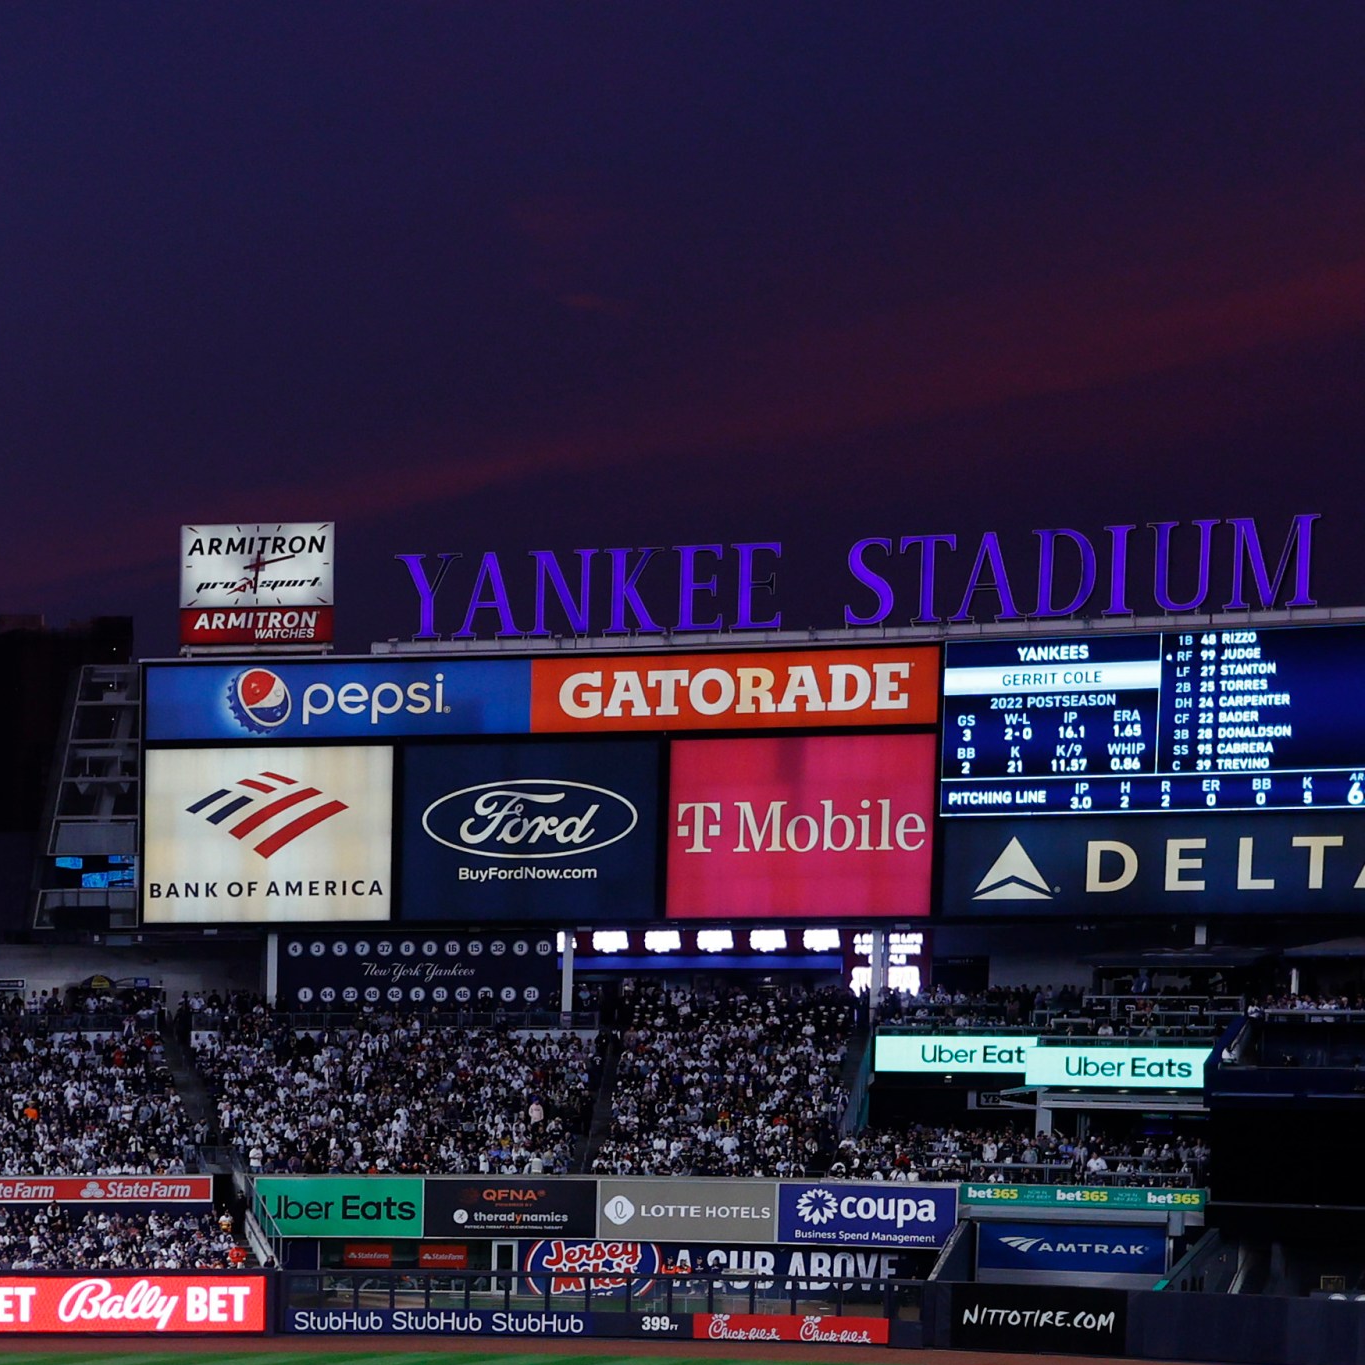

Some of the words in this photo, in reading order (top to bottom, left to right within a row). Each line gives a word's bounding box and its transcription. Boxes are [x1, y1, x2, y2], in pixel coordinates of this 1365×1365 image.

[188, 535, 326, 556] ARMITRON
[259, 577, 320, 591] sport
[394, 541, 782, 640] YANKEE
[844, 512, 1322, 626] STADIUM
[194, 611, 317, 630] ARMITRON
[255, 628, 315, 639] WATCHES
[1178, 635, 1193, 646] 1B
[1200, 634, 1216, 645] 48
[1221, 632, 1257, 645] RIZZO
[1017, 645, 1089, 662] YANKEES
[1176, 650, 1192, 662] RF
[1200, 649, 1216, 661] 99
[1220, 647, 1261, 660] JUDGE
[1176, 666, 1191, 677] LF
[1200, 665, 1216, 676] 27
[1220, 662, 1277, 675] STANTON
[1002, 672, 1058, 687] GERRIT
[1063, 670, 1102, 684] COLE
[1175, 682, 1191, 693] 2B
[1199, 681, 1215, 692] 25
[1219, 679, 1268, 692] TORRES
[301, 672, 444, 724] pepsi
[558, 662, 910, 718] GATORADE
[990, 697, 1023, 709] 2022
[1027, 694, 1116, 708] POSTSEASON
[1174, 697, 1192, 708] DH
[1198, 697, 1214, 708] 24
[1218, 694, 1290, 707] CARPENTER
[957, 715, 976, 727] GS
[1005, 713, 1030, 725] W-L
[1064, 711, 1078, 723] IP
[1114, 710, 1141, 722] ERA
[1174, 713, 1190, 724] CF
[1198, 712, 1213, 724] 22
[1218, 711, 1259, 722] BADER
[1058, 725, 1085, 738] 16.1
[1113, 723, 1142, 737] 1.65
[1173, 729, 1189, 740] 3B
[1197, 728, 1212, 739] 28
[1217, 725, 1291, 738] DONALDSON
[957, 747, 976, 759] BB
[1056, 744, 1082, 757] K/9
[1108, 743, 1145, 755] WHIP
[1173, 745, 1189, 755] SS
[1197, 743, 1212, 755] 95
[1216, 742, 1274, 754] CABRERA
[1007, 760, 1022, 773] 21
[1051, 758, 1087, 772] 11.57
[1110, 757, 1141, 770] 0.86
[1196, 759, 1211, 771] 39
[1216, 757, 1269, 770] TREVINO
[1075, 782, 1089, 794] IP
[1202, 779, 1220, 791] ER
[1252, 778, 1271, 790] BB
[948, 791, 1012, 805] PITCHING
[1016, 790, 1047, 804] LINE
[1070, 796, 1092, 809] 3.0
[459, 791, 598, 846] Ford
[732, 798, 926, 854] Mobile
[1086, 835, 1365, 893] DELT
[458, 866, 597, 884] BuyFordNow.com
[150, 883, 219, 900] BANK
[227, 881, 261, 898] OF
[266, 880, 384, 898] AMERICA
[361, 963, 390, 976] New
[391, 963, 421, 983] York
[424, 963, 476, 983] Yankees
[921, 1044, 977, 1066] Uber
[982, 1045, 1025, 1065] Eat
[1065, 1056, 1126, 1079] Uber
[1131, 1057, 1193, 1079] Eats
[482, 1188, 537, 1201] QFNA
[967, 1186, 1018, 1200] bet365
[1056, 1188, 1108, 1203] bet365
[1147, 1191, 1200, 1206] bet365
[341, 1194, 416, 1221] Eats
[640, 1203, 701, 1217] LOTTE
[705, 1205, 771, 1219] HOTELS
[839, 1195, 936, 1228] coupa
[473, 1211, 569, 1224] theradynamics
[794, 1229, 837, 1240] Business
[838, 1230, 869, 1243] Spend
[871, 1231, 936, 1244] Management
[543, 1240, 642, 1268] Jersey
[1038, 1242, 1144, 1255] AMTRAK
[57, 1278, 180, 1330] Bally
[186, 1285, 250, 1322] BET
[293, 1310, 383, 1331] StubHub
[391, 1310, 482, 1332] StubHub
[491, 1312, 584, 1334] StubHub
[641, 1316, 670, 1331] 399
[962, 1304, 1116, 1333] NITTOTIRE.COM
